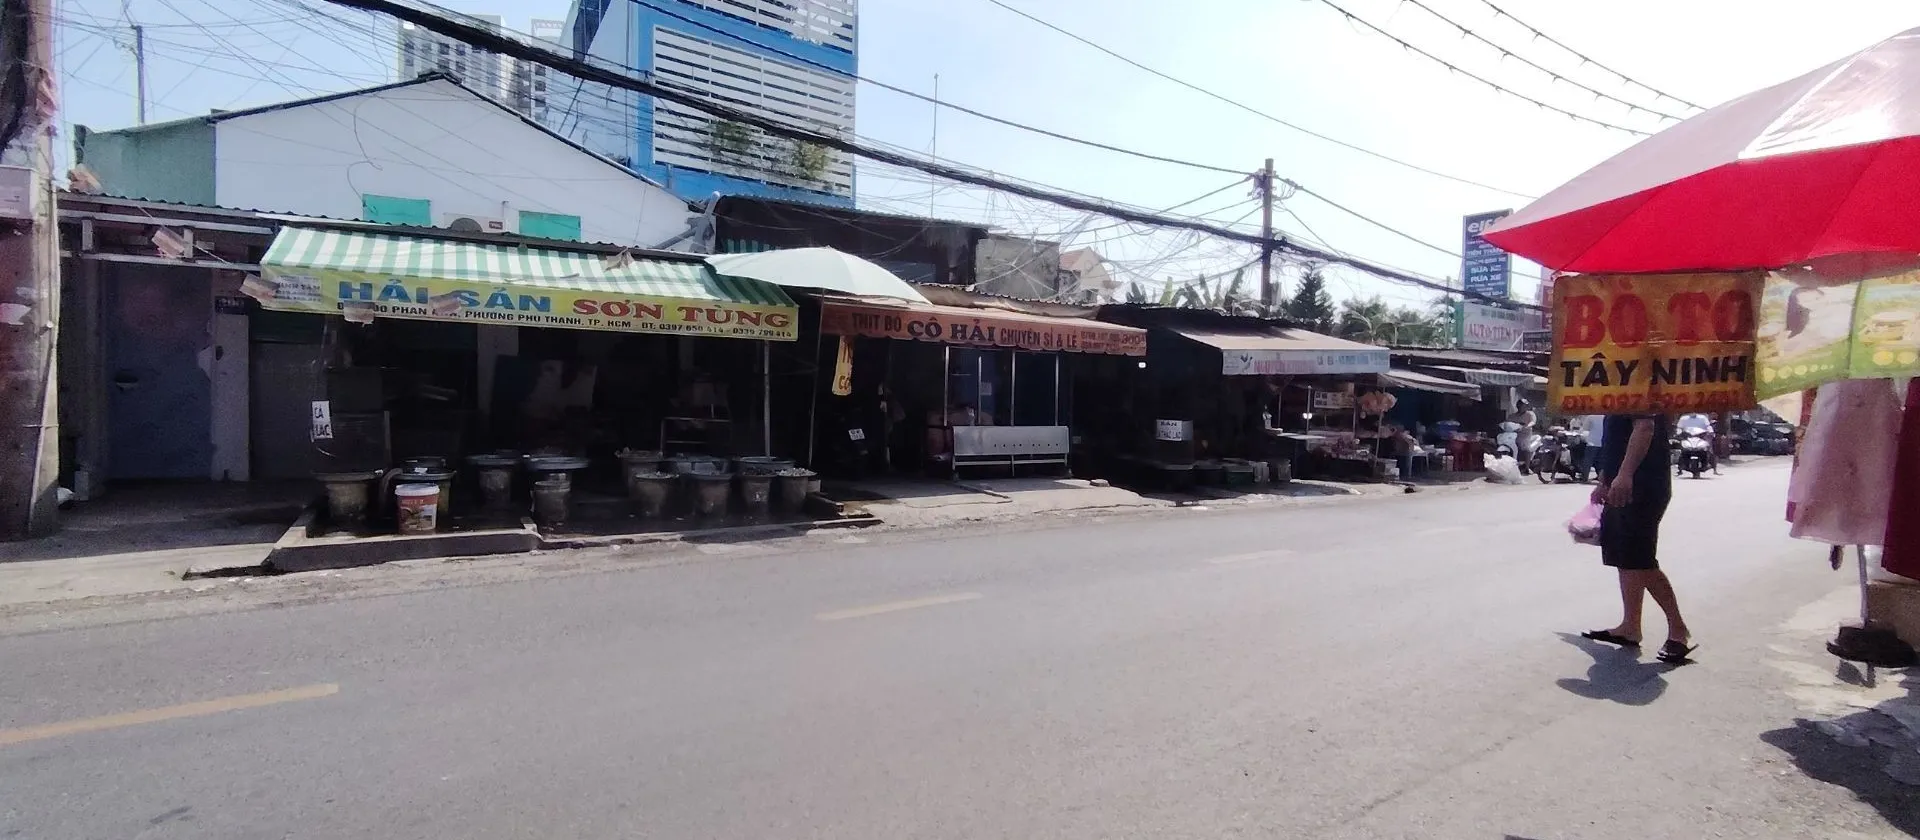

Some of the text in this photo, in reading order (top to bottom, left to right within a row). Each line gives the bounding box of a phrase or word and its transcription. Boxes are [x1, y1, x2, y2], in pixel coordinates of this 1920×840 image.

[339, 279, 429, 304] HẢI
[452, 286, 551, 313] SẢN
[573, 298, 664, 320] SƠN
[676, 303, 793, 328] TÙNG
[392, 306, 428, 316] PHAN
[588, 318, 603, 327] TP.
[608, 320, 631, 328] HCM
[907, 317, 943, 338] CÔ
[950, 318, 995, 342] HẢI
[1057, 333, 1064, 348] &
[1560, 352, 1747, 387] TÂY NINH
